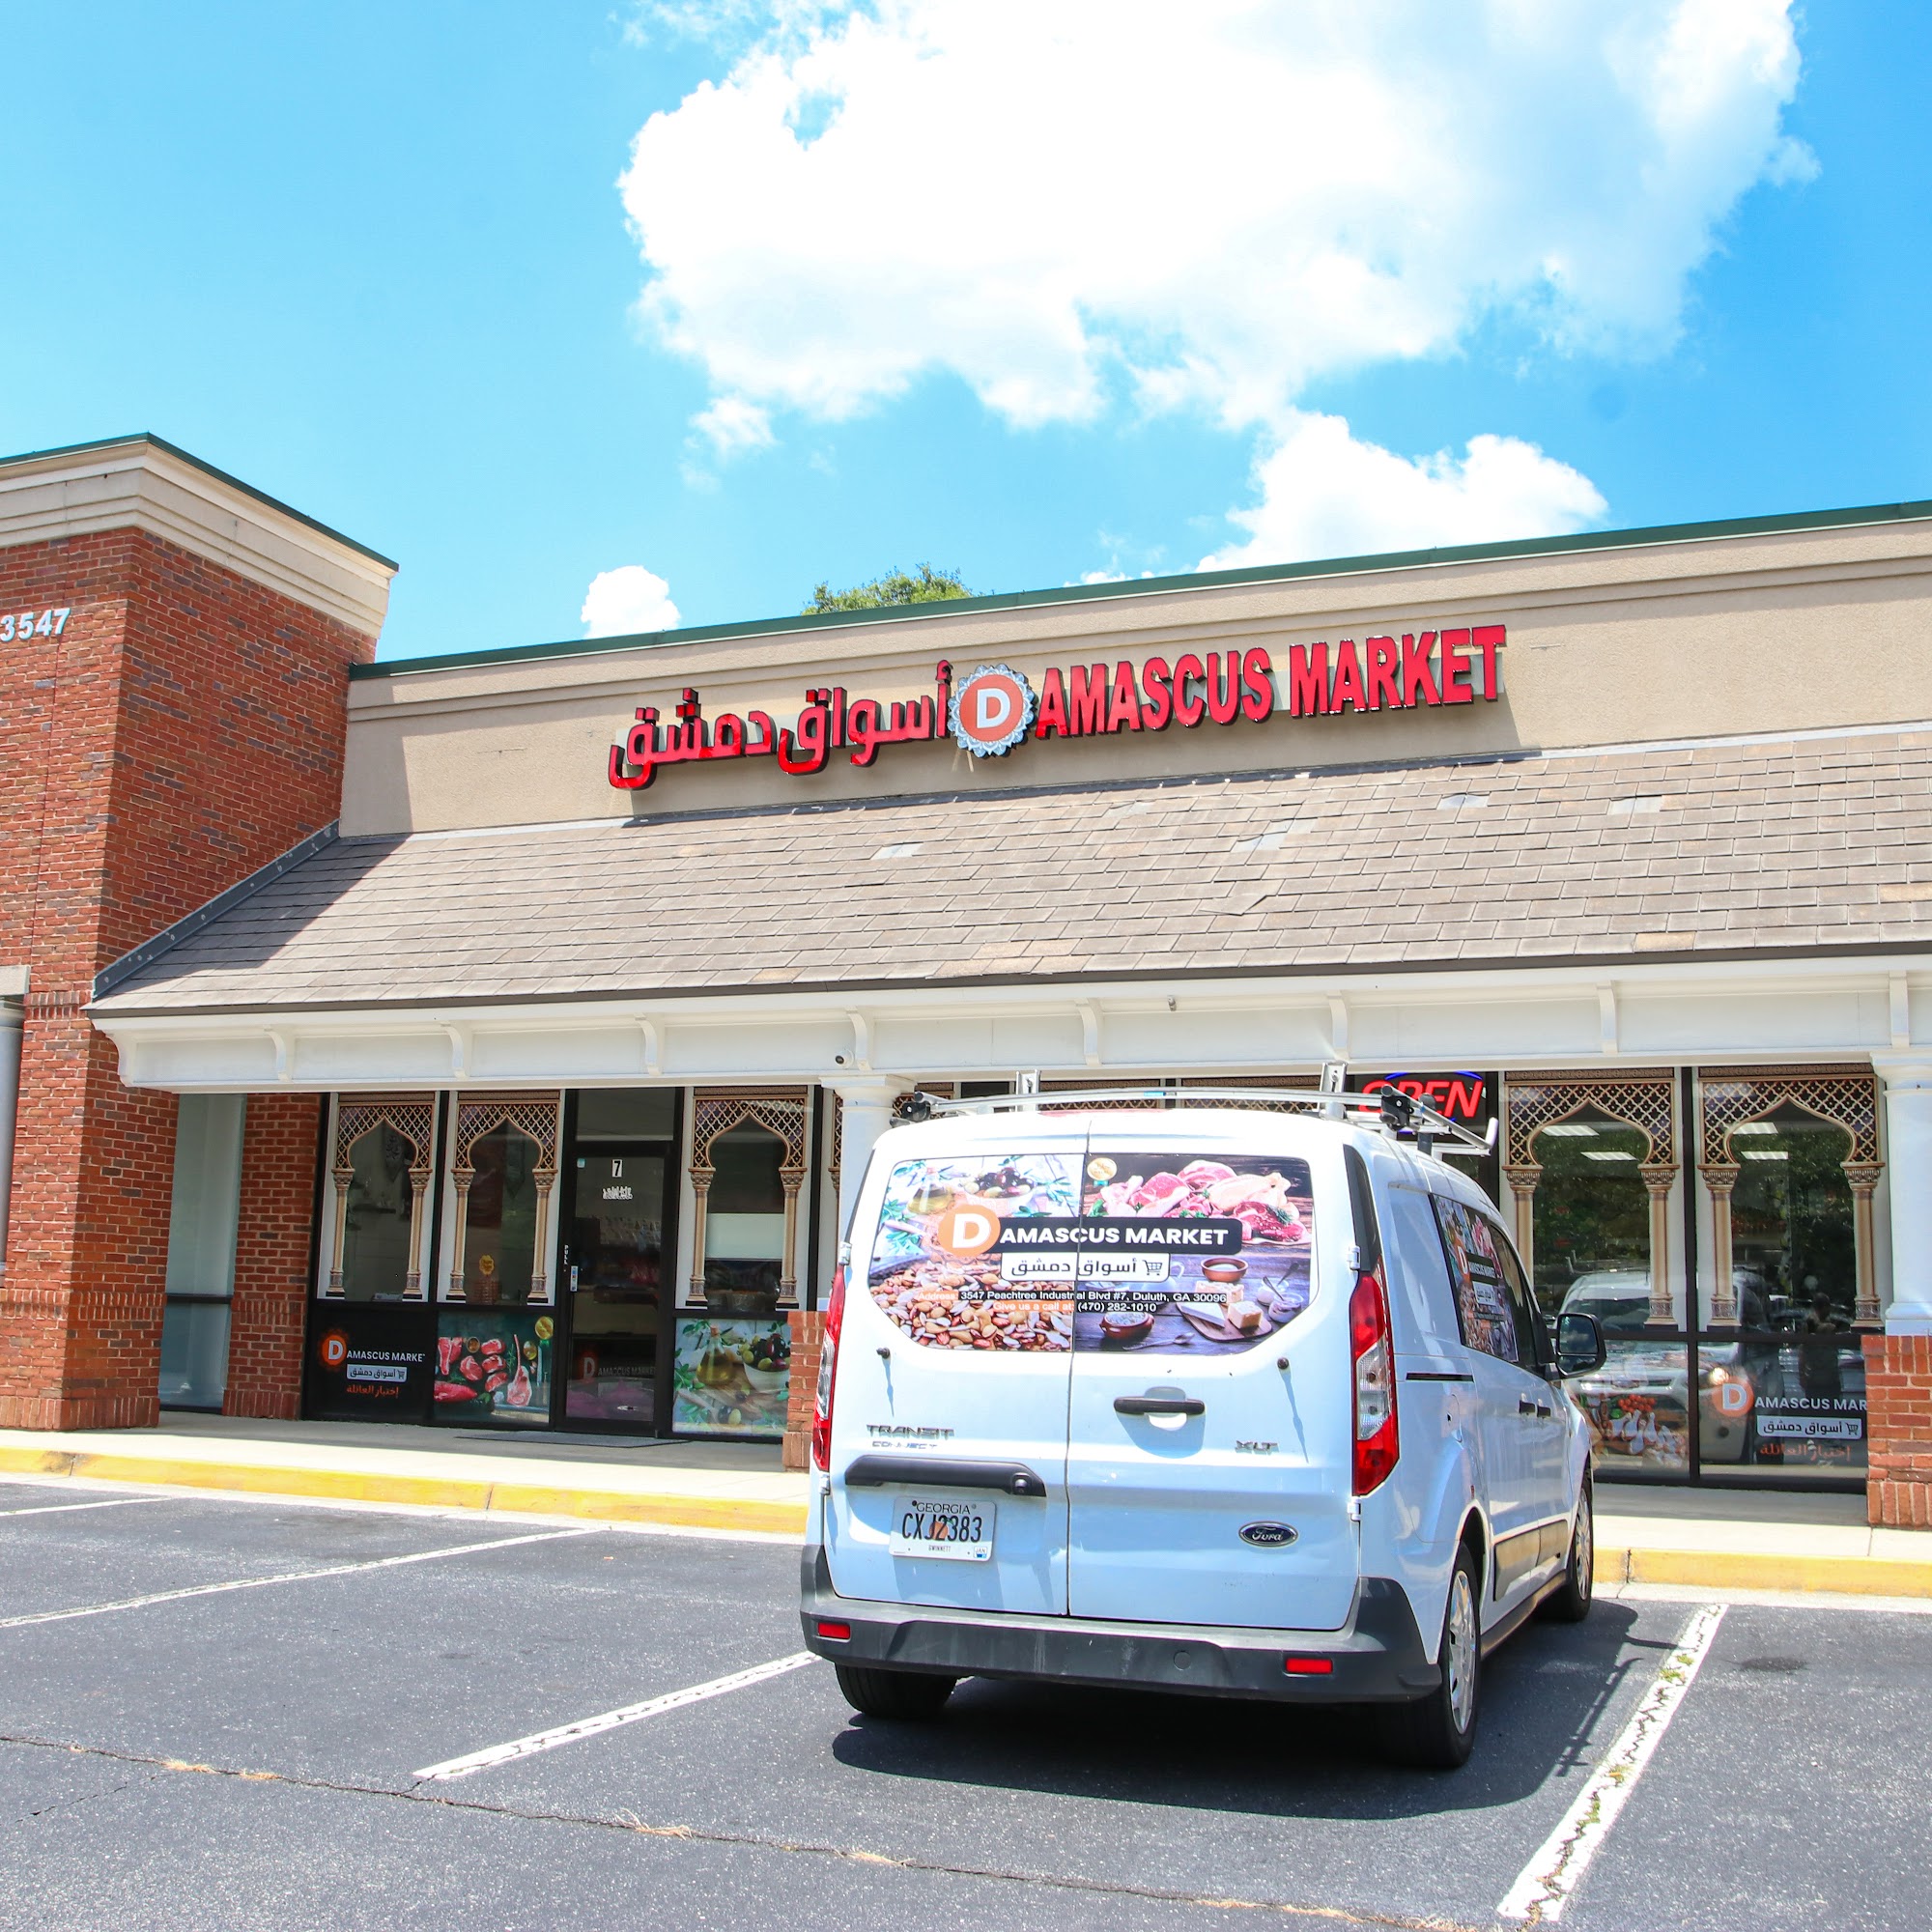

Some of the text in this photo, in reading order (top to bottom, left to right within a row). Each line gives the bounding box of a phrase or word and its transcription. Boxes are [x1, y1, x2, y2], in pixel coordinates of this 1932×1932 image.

[0, 608, 71, 641] 3547
[1290, 624, 1506, 719] MARKET
[609, 688, 777, 790] دمشق
[613, 1160, 621, 1177] 7
[1124, 1227, 1229, 1245] MARKET
[1011, 1258, 1070, 1276] دمشق
[960, 1291, 984, 1300] 3547
[987, 1291, 1037, 1300] Peachtree
[1039, 1291, 1085, 1300] Industral
[1088, 1292, 1110, 1300] Blvd
[1113, 1292, 1129, 1301] #7,
[1132, 1293, 1170, 1302] Duluth,
[1173, 1293, 1190, 1302] GA
[1193, 1293, 1227, 1303] 30096
[993, 1301, 1014, 1311] Give
[1042, 1301, 1060, 1311] call
[1077, 1302, 1104, 1313] (470)
[1107, 1302, 1157, 1312] 282-1010
[391, 1352, 425, 1362] MARKE
[1763, 1420, 1802, 1434] دمشق
[1235, 1440, 1280, 1456] XLT
[916, 1502, 971, 1515] GEORGIA
[902, 1513, 982, 1543] CXJ2383
[1251, 1526, 1283, 1543] Ford
